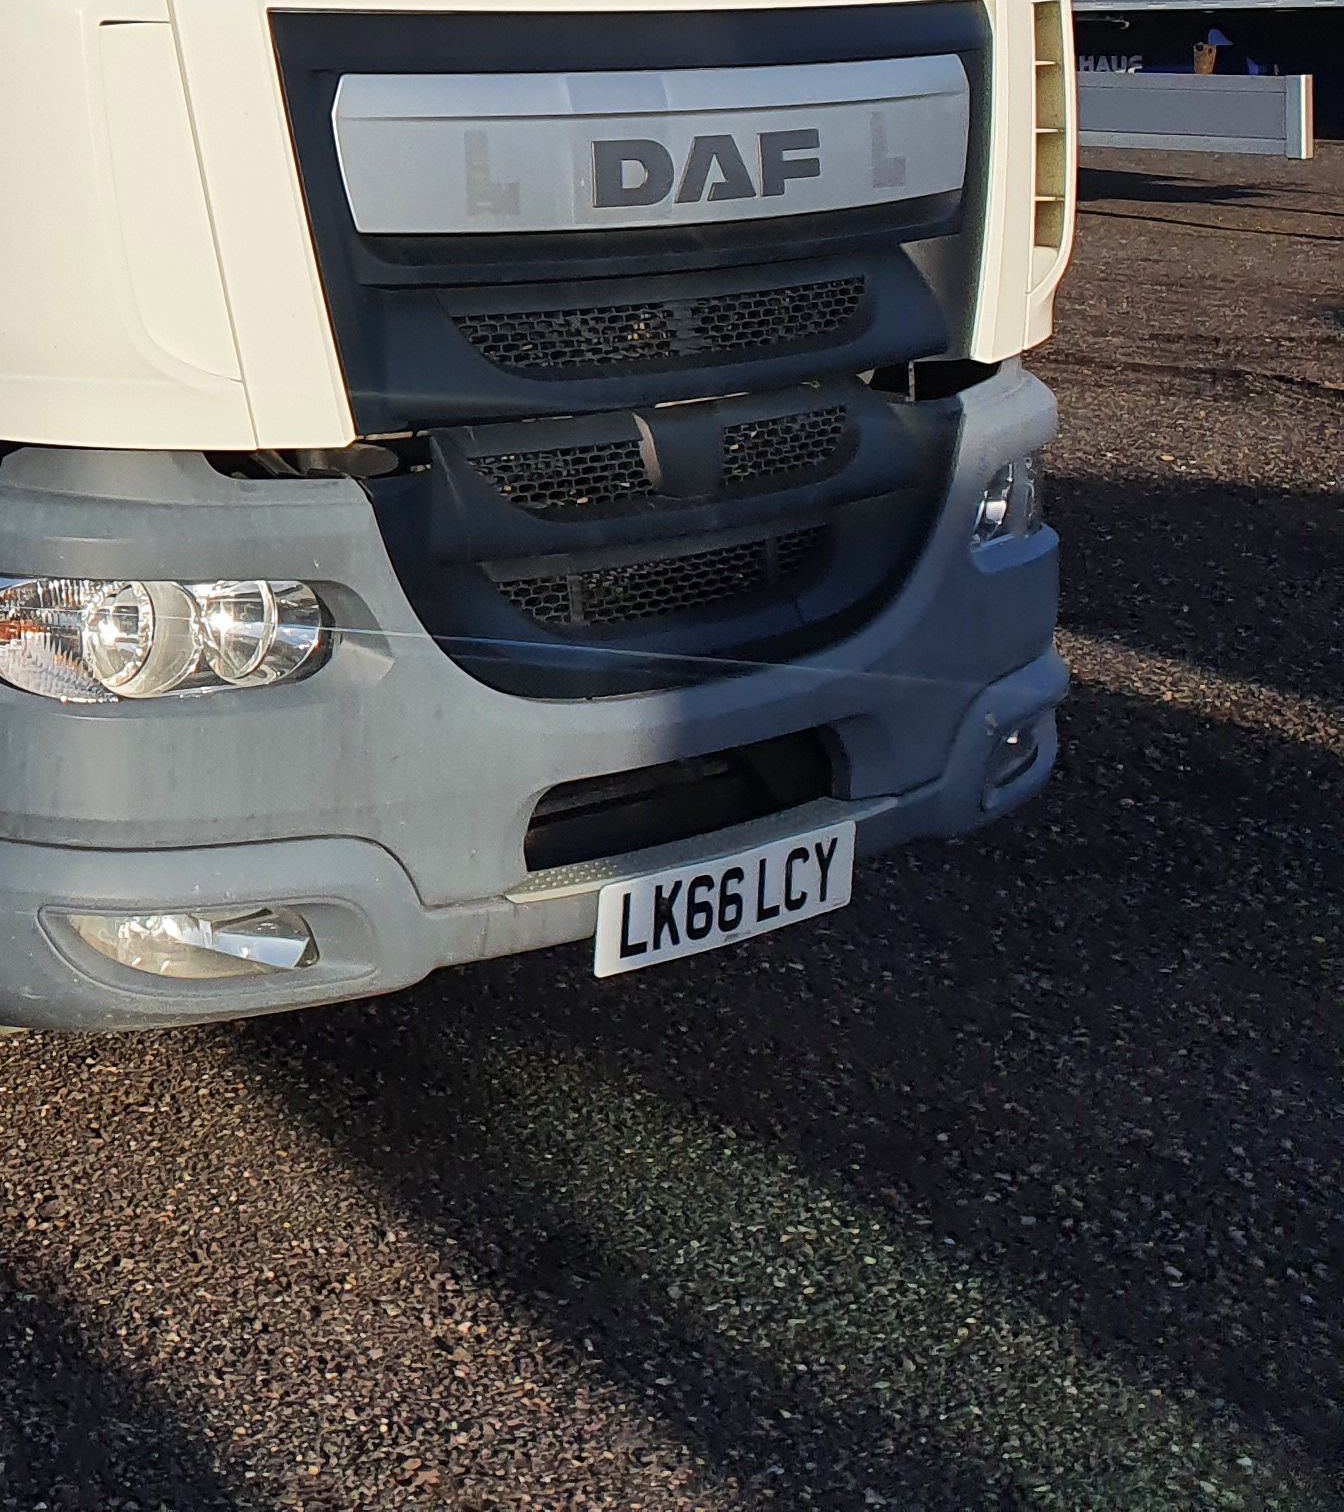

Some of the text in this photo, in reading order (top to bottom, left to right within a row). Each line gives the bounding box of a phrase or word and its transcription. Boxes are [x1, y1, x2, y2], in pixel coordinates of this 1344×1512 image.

[592, 128, 822, 208] DAF
[619, 837, 839, 960] LK66 LCY
